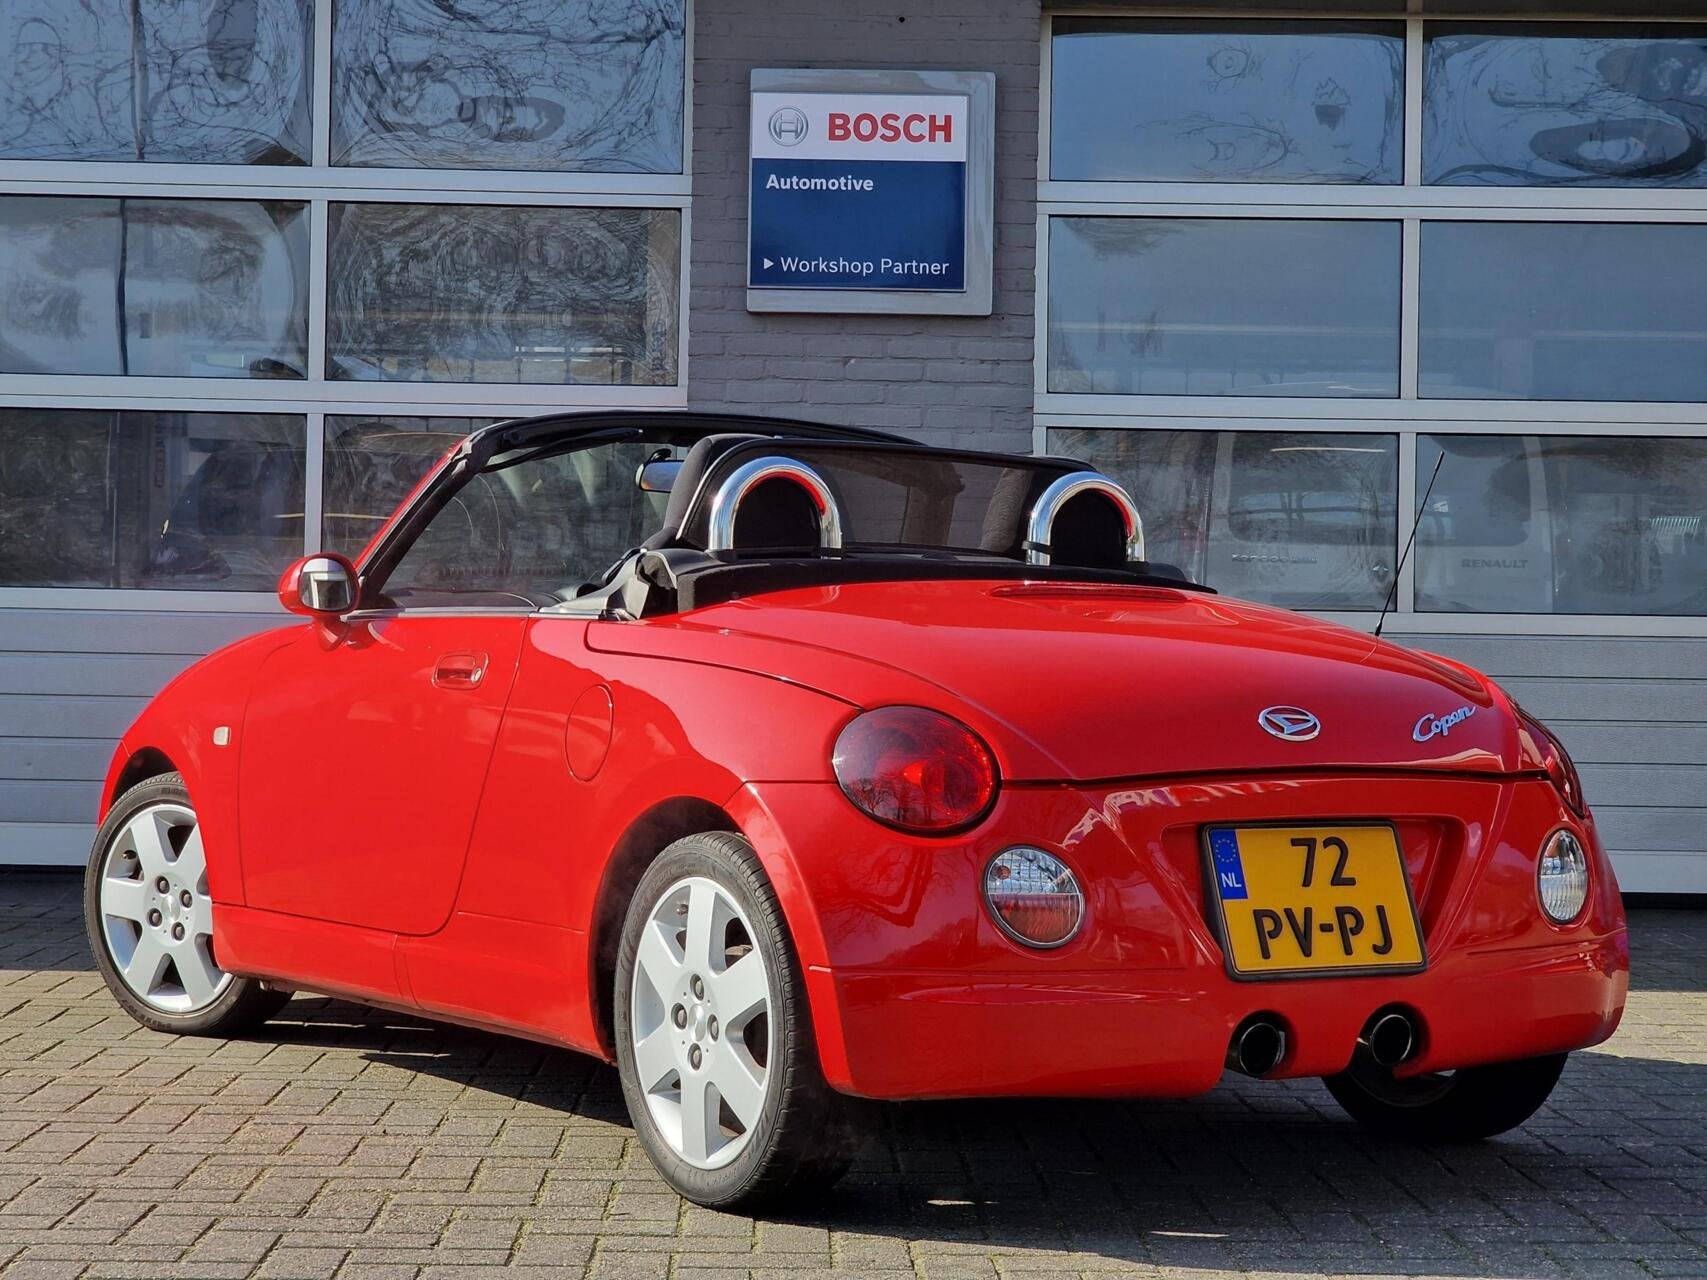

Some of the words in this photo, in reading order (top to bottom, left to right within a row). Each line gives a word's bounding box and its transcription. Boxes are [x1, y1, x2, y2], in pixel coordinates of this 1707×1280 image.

[828, 113, 952, 143] BOSCH
[766, 174, 874, 191] Automotive
[780, 257, 874, 277] Workshop
[880, 258, 950, 275] Partner
[1461, 559, 1529, 569] RENAULT
[1290, 836, 1357, 888] 72
[1221, 872, 1242, 888] NL
[1252, 904, 1393, 960] PV-PJ
